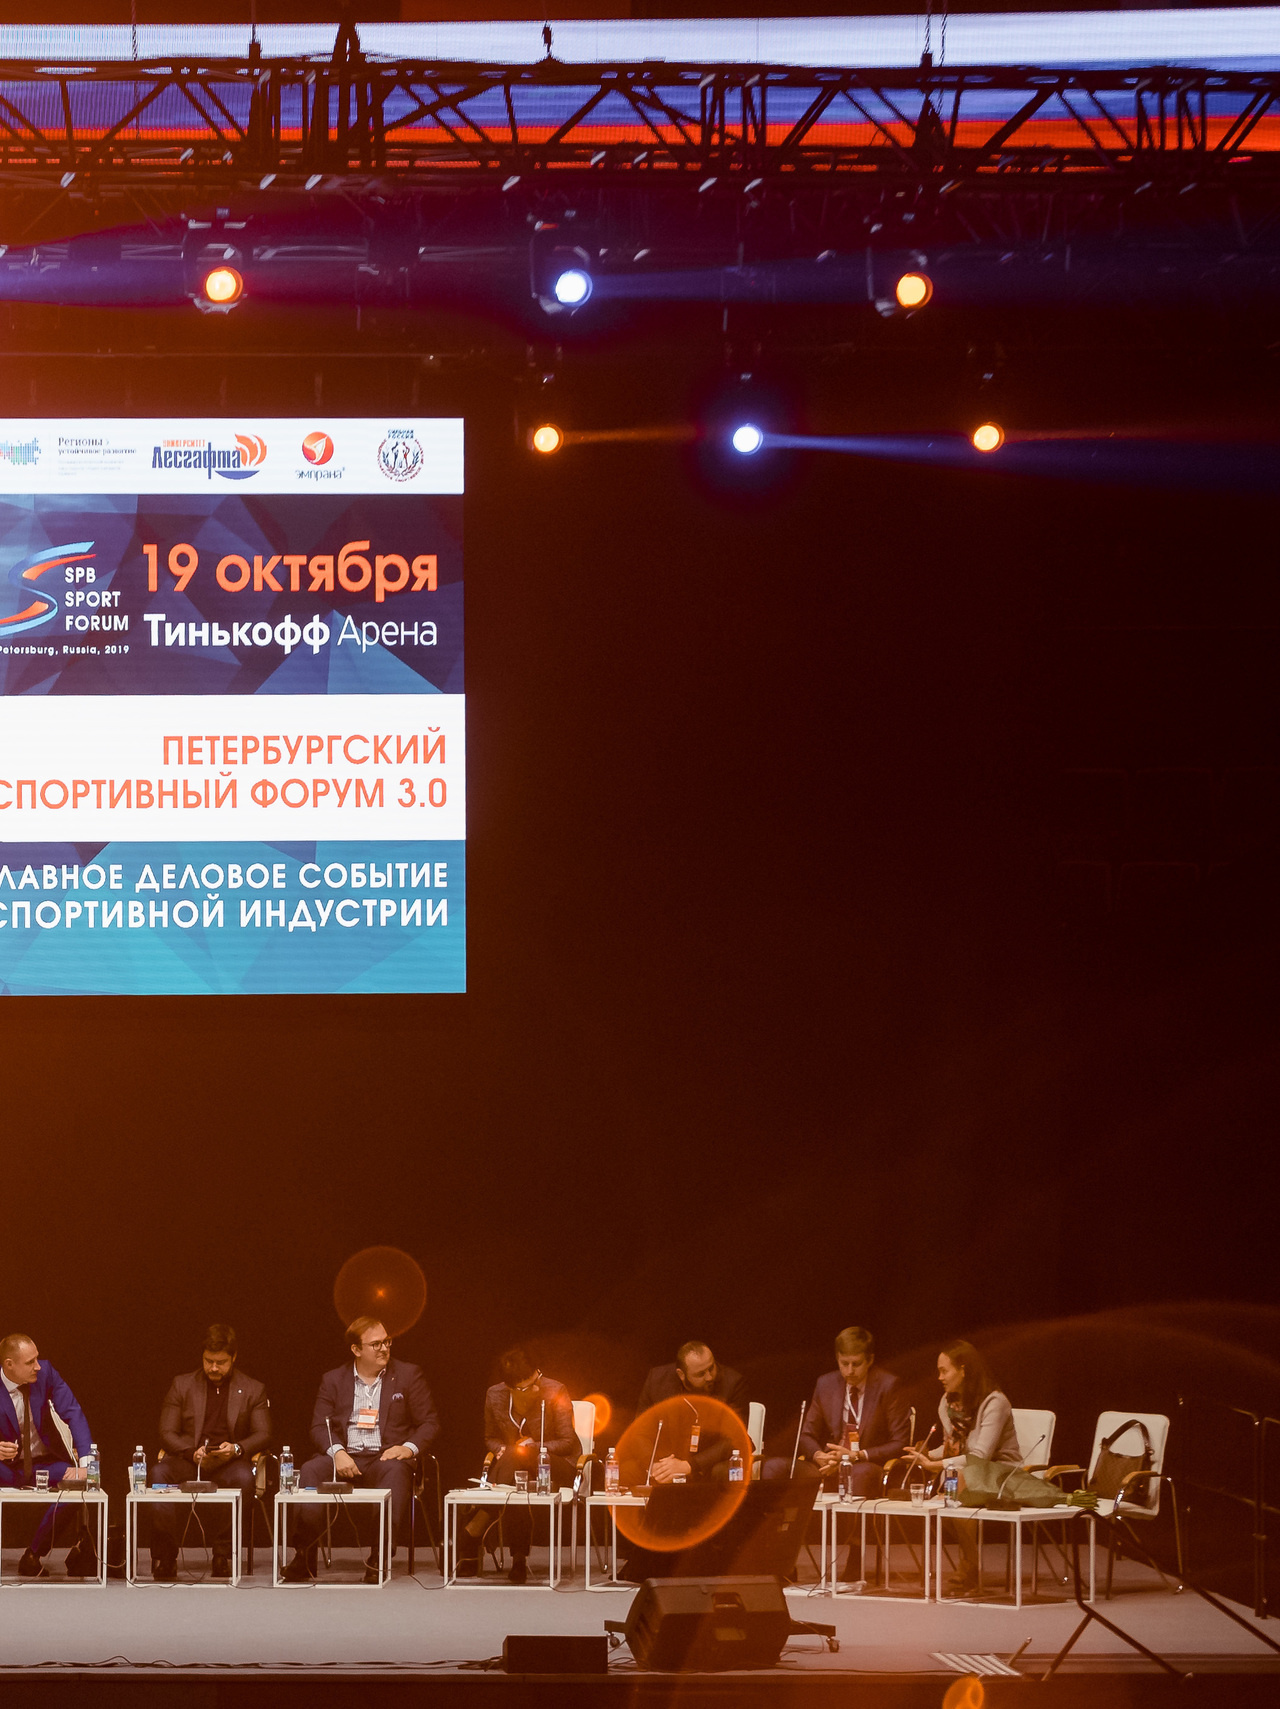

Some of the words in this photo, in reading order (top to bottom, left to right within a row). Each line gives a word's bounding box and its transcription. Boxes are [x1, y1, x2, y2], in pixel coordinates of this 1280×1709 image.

[58, 437, 103, 447] Регионы
[151, 441, 241, 480] Лесгафта
[64, 566, 96, 584] SPB
[142, 543, 199, 592] 19
[215, 540, 438, 602] октября
[64, 590, 121, 608] SPORT
[65, 614, 129, 631] FORUM
[143, 613, 330, 655] Тинькофф
[337, 614, 438, 653] Арена
[62, 645, 100, 656] Russia,
[104, 645, 130, 655] 2019
[163, 726, 446, 765] ПЕТЕРБУРГСКИЙ
[250, 778, 384, 809] ФОРУМ
[397, 777, 447, 808] 3.0
[135, 863, 286, 893] ДЕЛОВОЕ
[298, 862, 448, 889] СОБЫТИЕ
[240, 898, 448, 932] ИНДУСТРИИ
